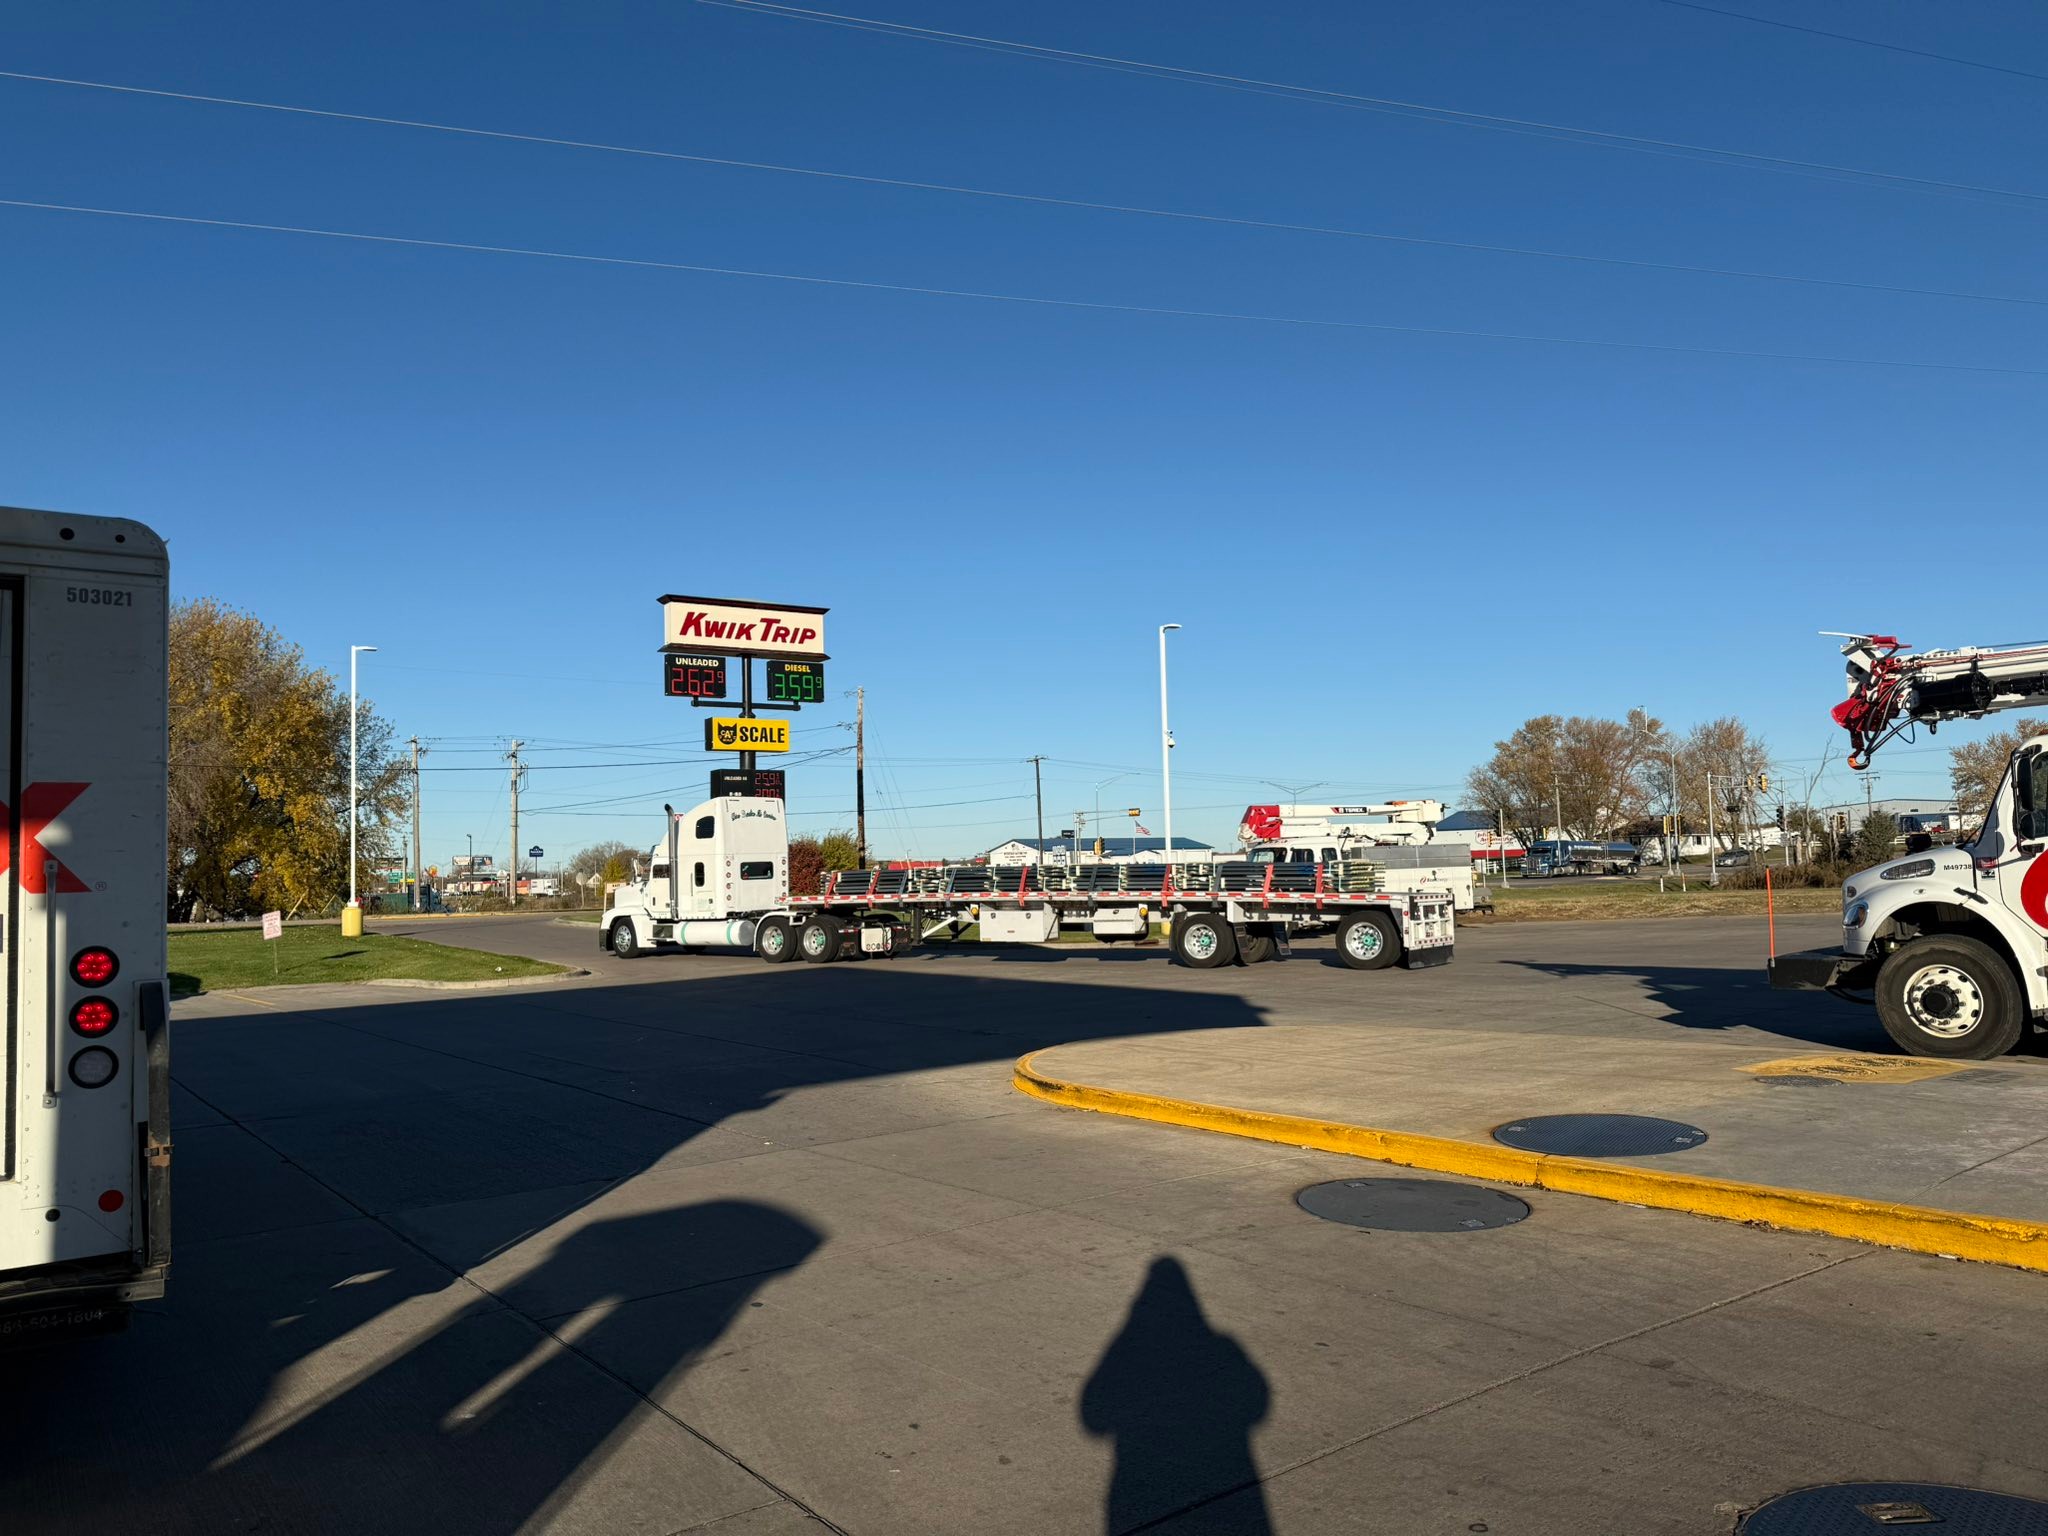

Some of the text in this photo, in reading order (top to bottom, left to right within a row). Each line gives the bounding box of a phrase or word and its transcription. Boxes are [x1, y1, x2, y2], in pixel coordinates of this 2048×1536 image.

[67, 587, 133, 607] 503021
[675, 657, 719, 667] UNLEADED
[784, 664, 811, 673] DIESEL
[720, 726, 785, 743] CAT SCALE
